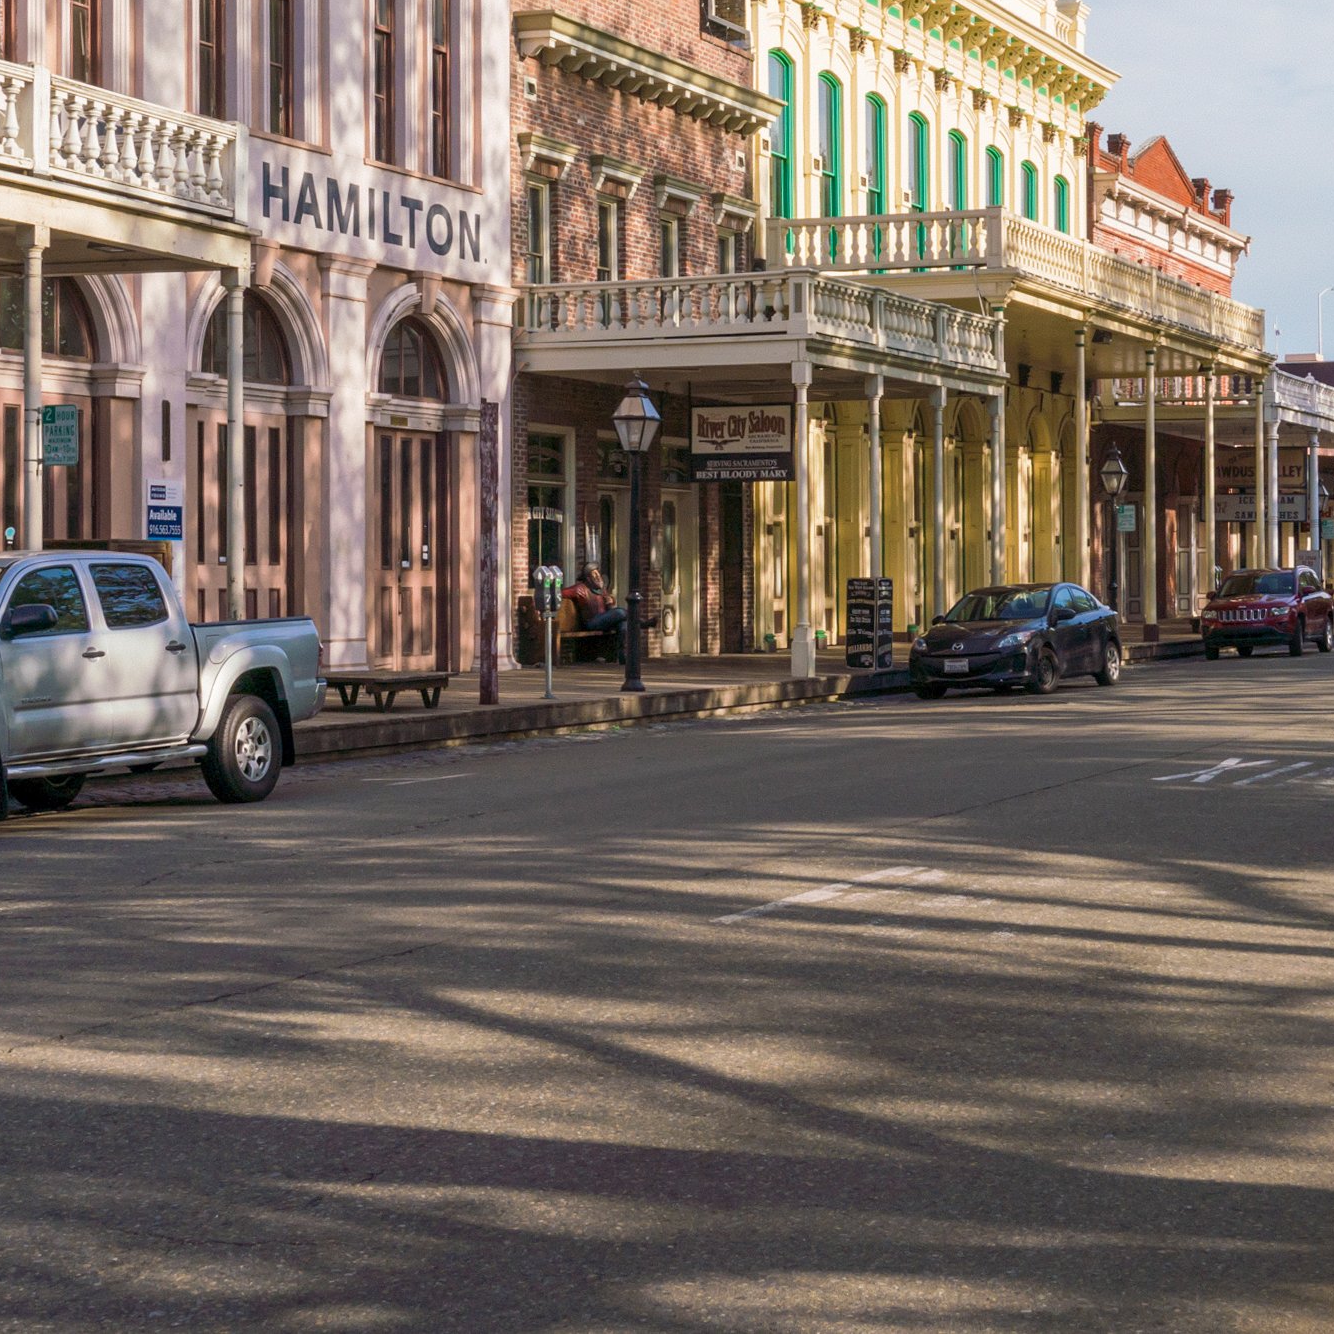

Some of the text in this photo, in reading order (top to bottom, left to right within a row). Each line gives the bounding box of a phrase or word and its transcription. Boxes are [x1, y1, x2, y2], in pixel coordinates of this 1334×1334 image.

[46, 408, 52, 421] 2
[696, 409, 786, 439] River City Saloon
[45, 425, 75, 436] PARKING
[707, 459, 731, 467] SERVING
[696, 469, 788, 479] BEST BLOODY MARY
[149, 509, 177, 521] Available
